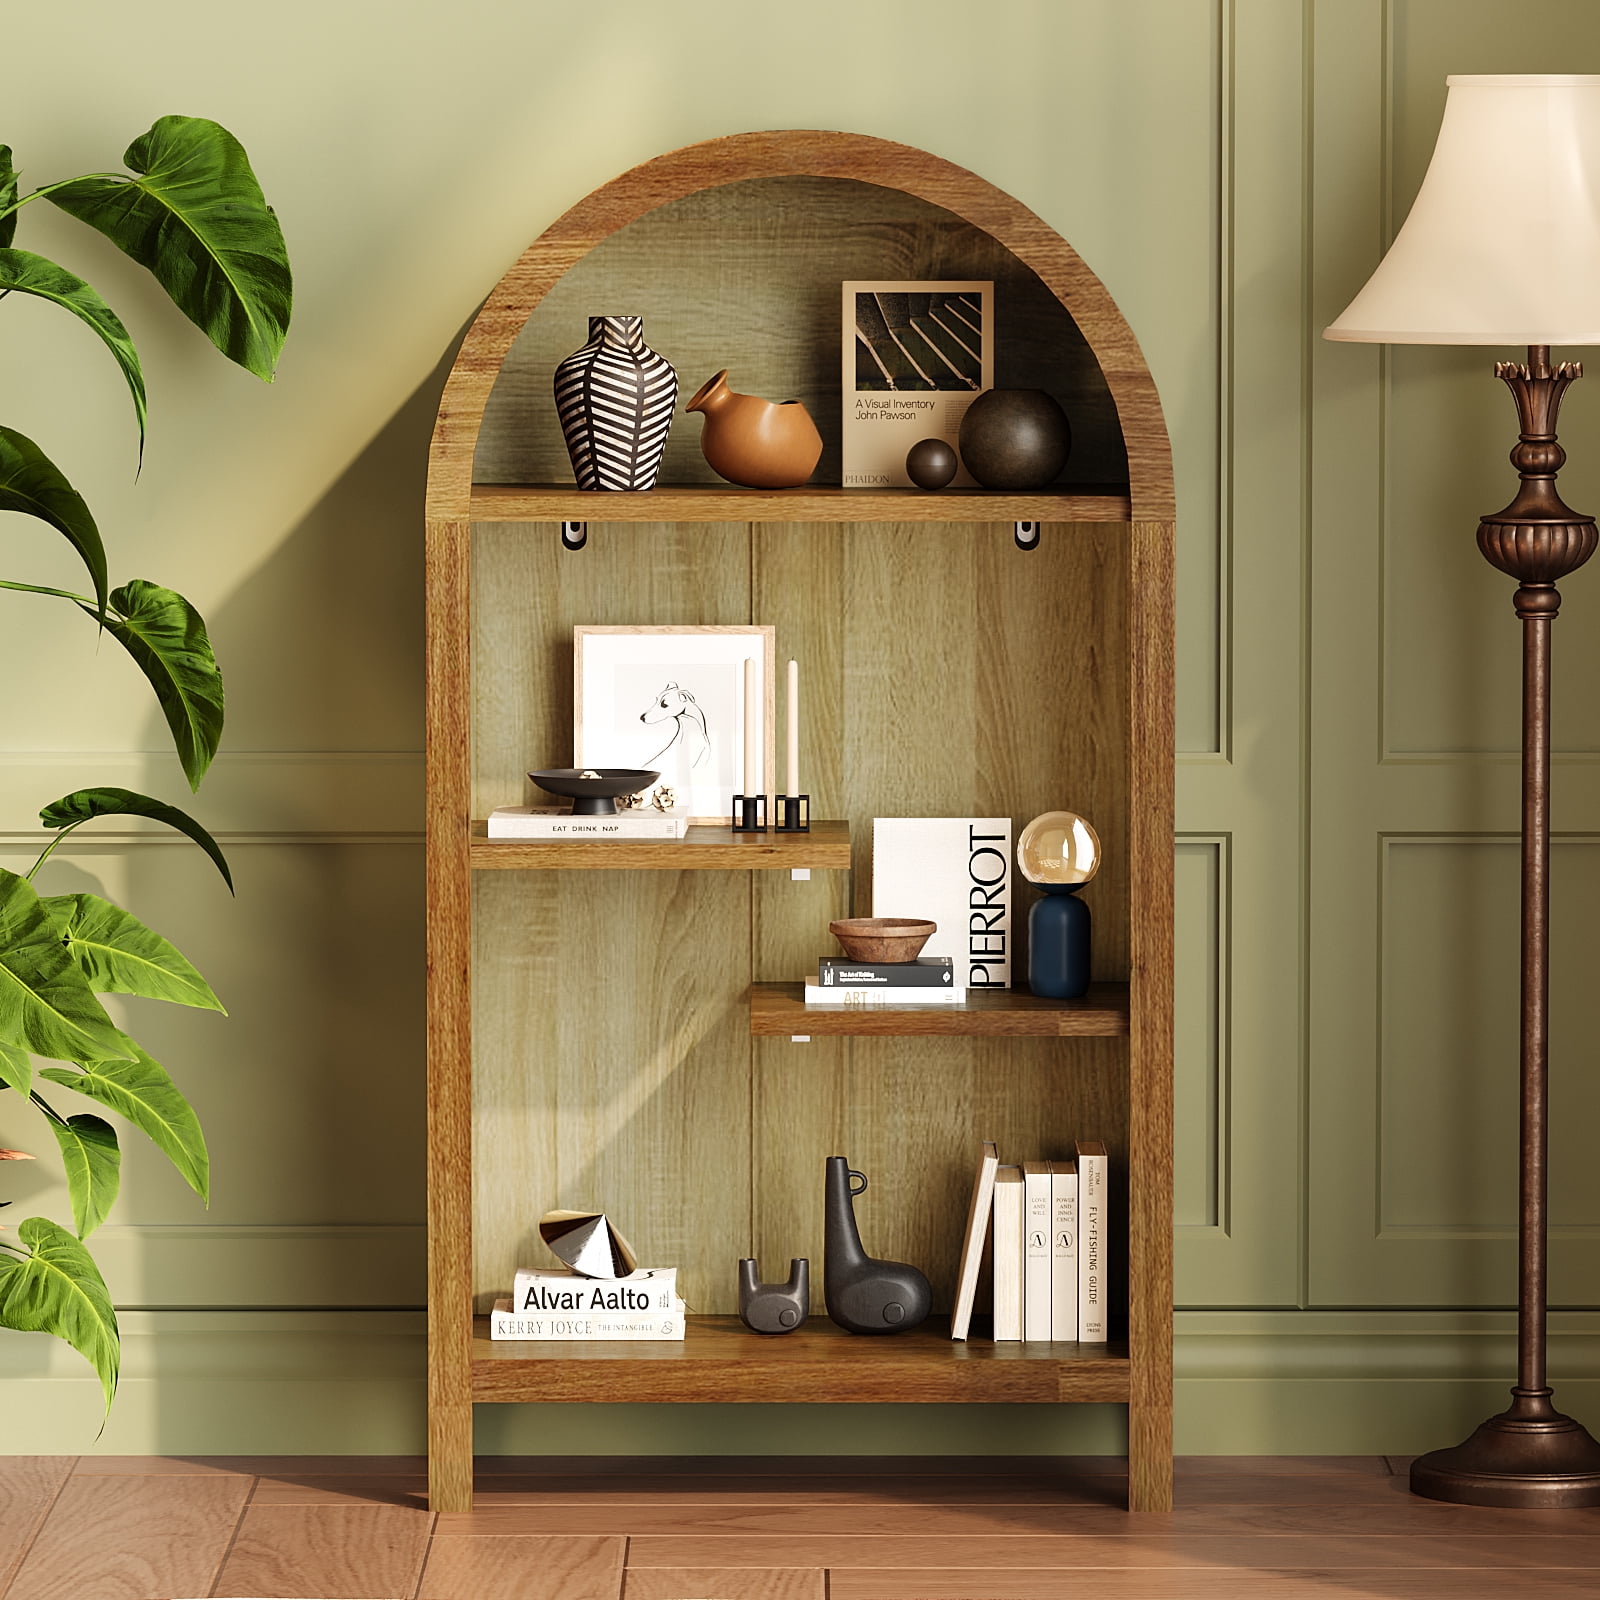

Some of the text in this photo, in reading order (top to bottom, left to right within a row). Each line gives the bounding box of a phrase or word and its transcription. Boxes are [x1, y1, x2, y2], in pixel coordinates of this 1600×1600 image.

[855, 399, 935, 411] A Visual Inventory
[855, 410, 916, 420] John Pawson
[845, 474, 890, 484] PHAIDON
[968, 824, 1007, 988] PIERROT
[843, 991, 868, 1004] ART
[1089, 1206, 1098, 1305] FLY-FISHING GUIDE
[523, 1286, 584, 1310] Alvar
[589, 1286, 650, 1310] Aalto
[498, 1321, 543, 1335] KERRY
[550, 1321, 593, 1336] JOYCE
